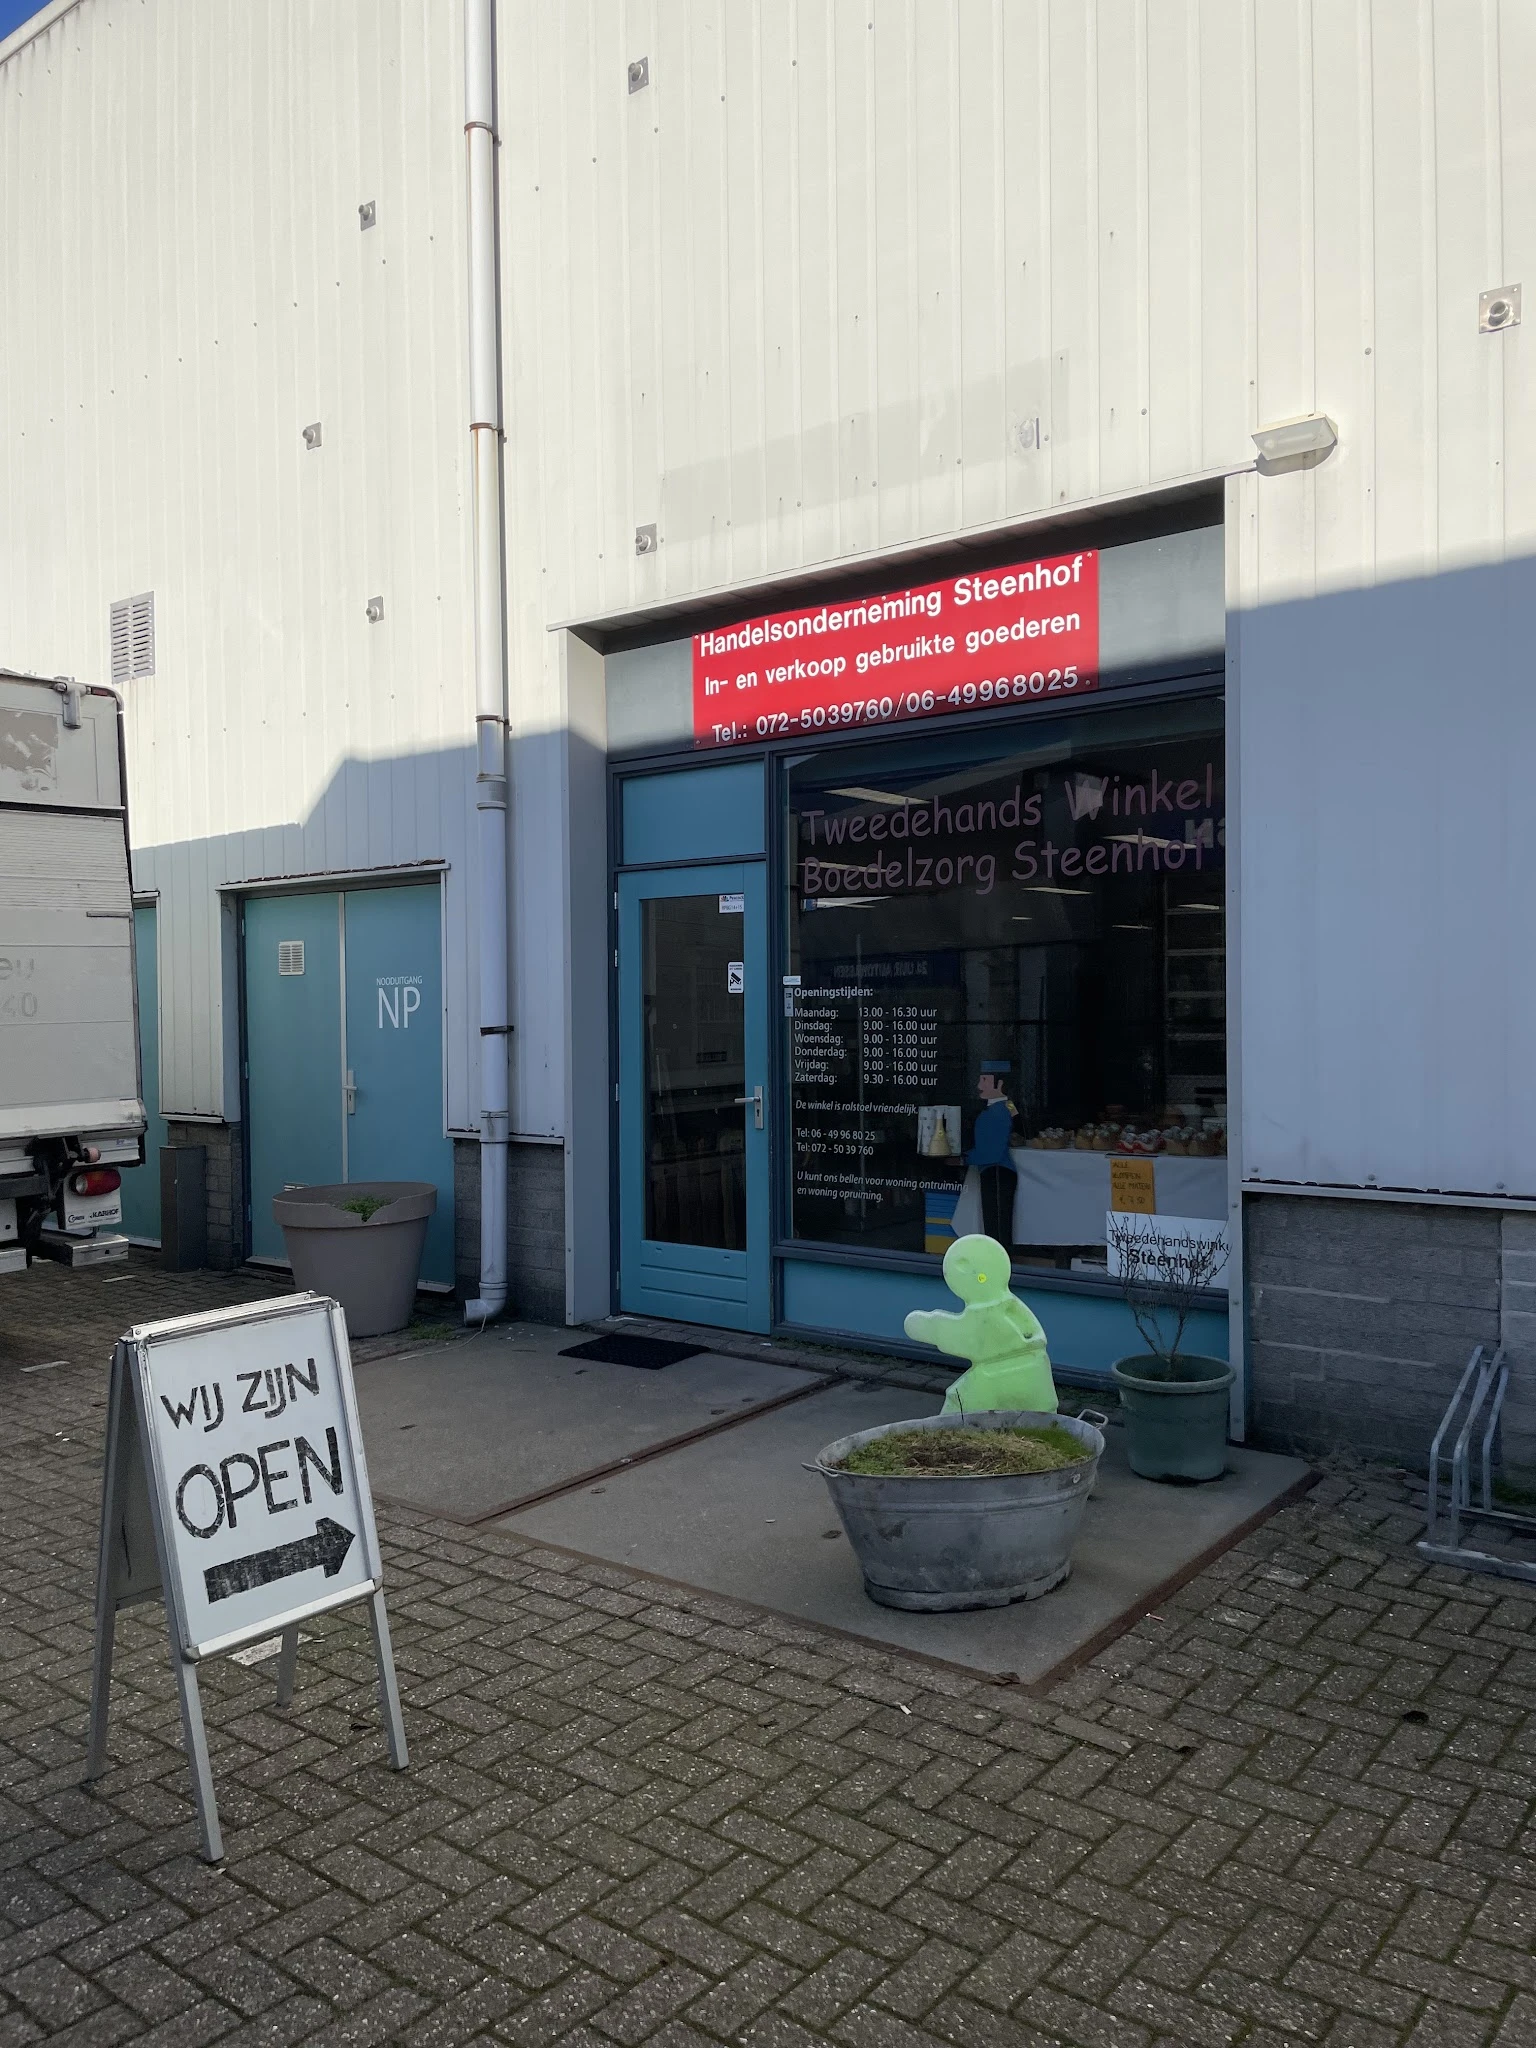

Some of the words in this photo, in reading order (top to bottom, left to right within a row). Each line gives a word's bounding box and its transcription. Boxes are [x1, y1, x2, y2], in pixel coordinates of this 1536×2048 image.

[700, 590, 942, 658] Handelsonderneming
[954, 556, 1084, 606] Steenhof
[704, 678, 729, 697] In-
[736, 669, 757, 690] en
[765, 650, 847, 685] verkoop
[856, 632, 956, 673] gebruikte
[965, 610, 1081, 654] goederen
[711, 720, 748, 744] Tel.:
[801, 785, 1041, 845] Tweedehands
[1064, 762, 1213, 821] Winkel
[803, 847, 996, 895] Boedelzorg
[1012, 828, 1203, 881] Steenhof
[376, 976, 423, 986] NOODUITGANG
[794, 986, 874, 999] Openingstijden:
[379, 987, 421, 1028] NP
[794, 1007, 839, 1020] Maandag:
[858, 1007, 883, 1017] 13.00
[892, 1007, 918, 1017] 16.30
[920, 1009, 938, 1017] uur
[794, 1020, 833, 1032] Dinsdag:
[863, 1021, 883, 1031] 9.00
[892, 1021, 918, 1031] 16.00
[920, 1023, 938, 1031] uur
[794, 1034, 844, 1046] Woensdag:
[863, 1034, 883, 1044] 9.00
[892, 1034, 918, 1045] 13.00
[920, 1037, 938, 1045] uur
[794, 1046, 848, 1059] Donderdag:
[863, 1047, 883, 1058] 9.00
[892, 1048, 918, 1058] 16.00
[920, 1050, 938, 1059] uur
[794, 1059, 829, 1071] Vrijdag:
[863, 1061, 883, 1071] 9.00
[892, 1061, 918, 1072] 16.00
[920, 1064, 938, 1072] uur
[794, 1072, 838, 1085] Zaterdag:
[863, 1074, 883, 1084] 9.30
[892, 1075, 918, 1085] 16.00
[920, 1077, 938, 1086] uur
[796, 1100, 807, 1110] De
[808, 1101, 833, 1111] winkel
[834, 1102, 841, 1111] is
[796, 1128, 810, 1138] Tel:
[811, 1129, 822, 1138] 06
[828, 1129, 839, 1138] 49
[840, 1130, 851, 1139] 96
[852, 1130, 863, 1139] 80
[865, 1131, 875, 1140] 25
[796, 1142, 810, 1152] Tel:
[811, 1143, 827, 1153] 072
[833, 1145, 844, 1154] 50
[845, 1145, 856, 1154] 39
[858, 1146, 874, 1155] 760
[797, 1171, 804, 1180] U
[804, 1172, 822, 1182] kunt
[824, 1175, 838, 1183] ons
[839, 1174, 863, 1184] bellen
[865, 1177, 884, 1186] voor
[885, 1177, 918, 1190] woning
[919, 1180, 968, 1193] ontruiming
[797, 1187, 807, 1195] en
[808, 1187, 838, 1199] woning
[839, 1189, 884, 1203] opruiming.
[160, 1382, 224, 1432] WIJ
[236, 1358, 321, 1419] ZIJN
[175, 1426, 344, 1539] OPEN
